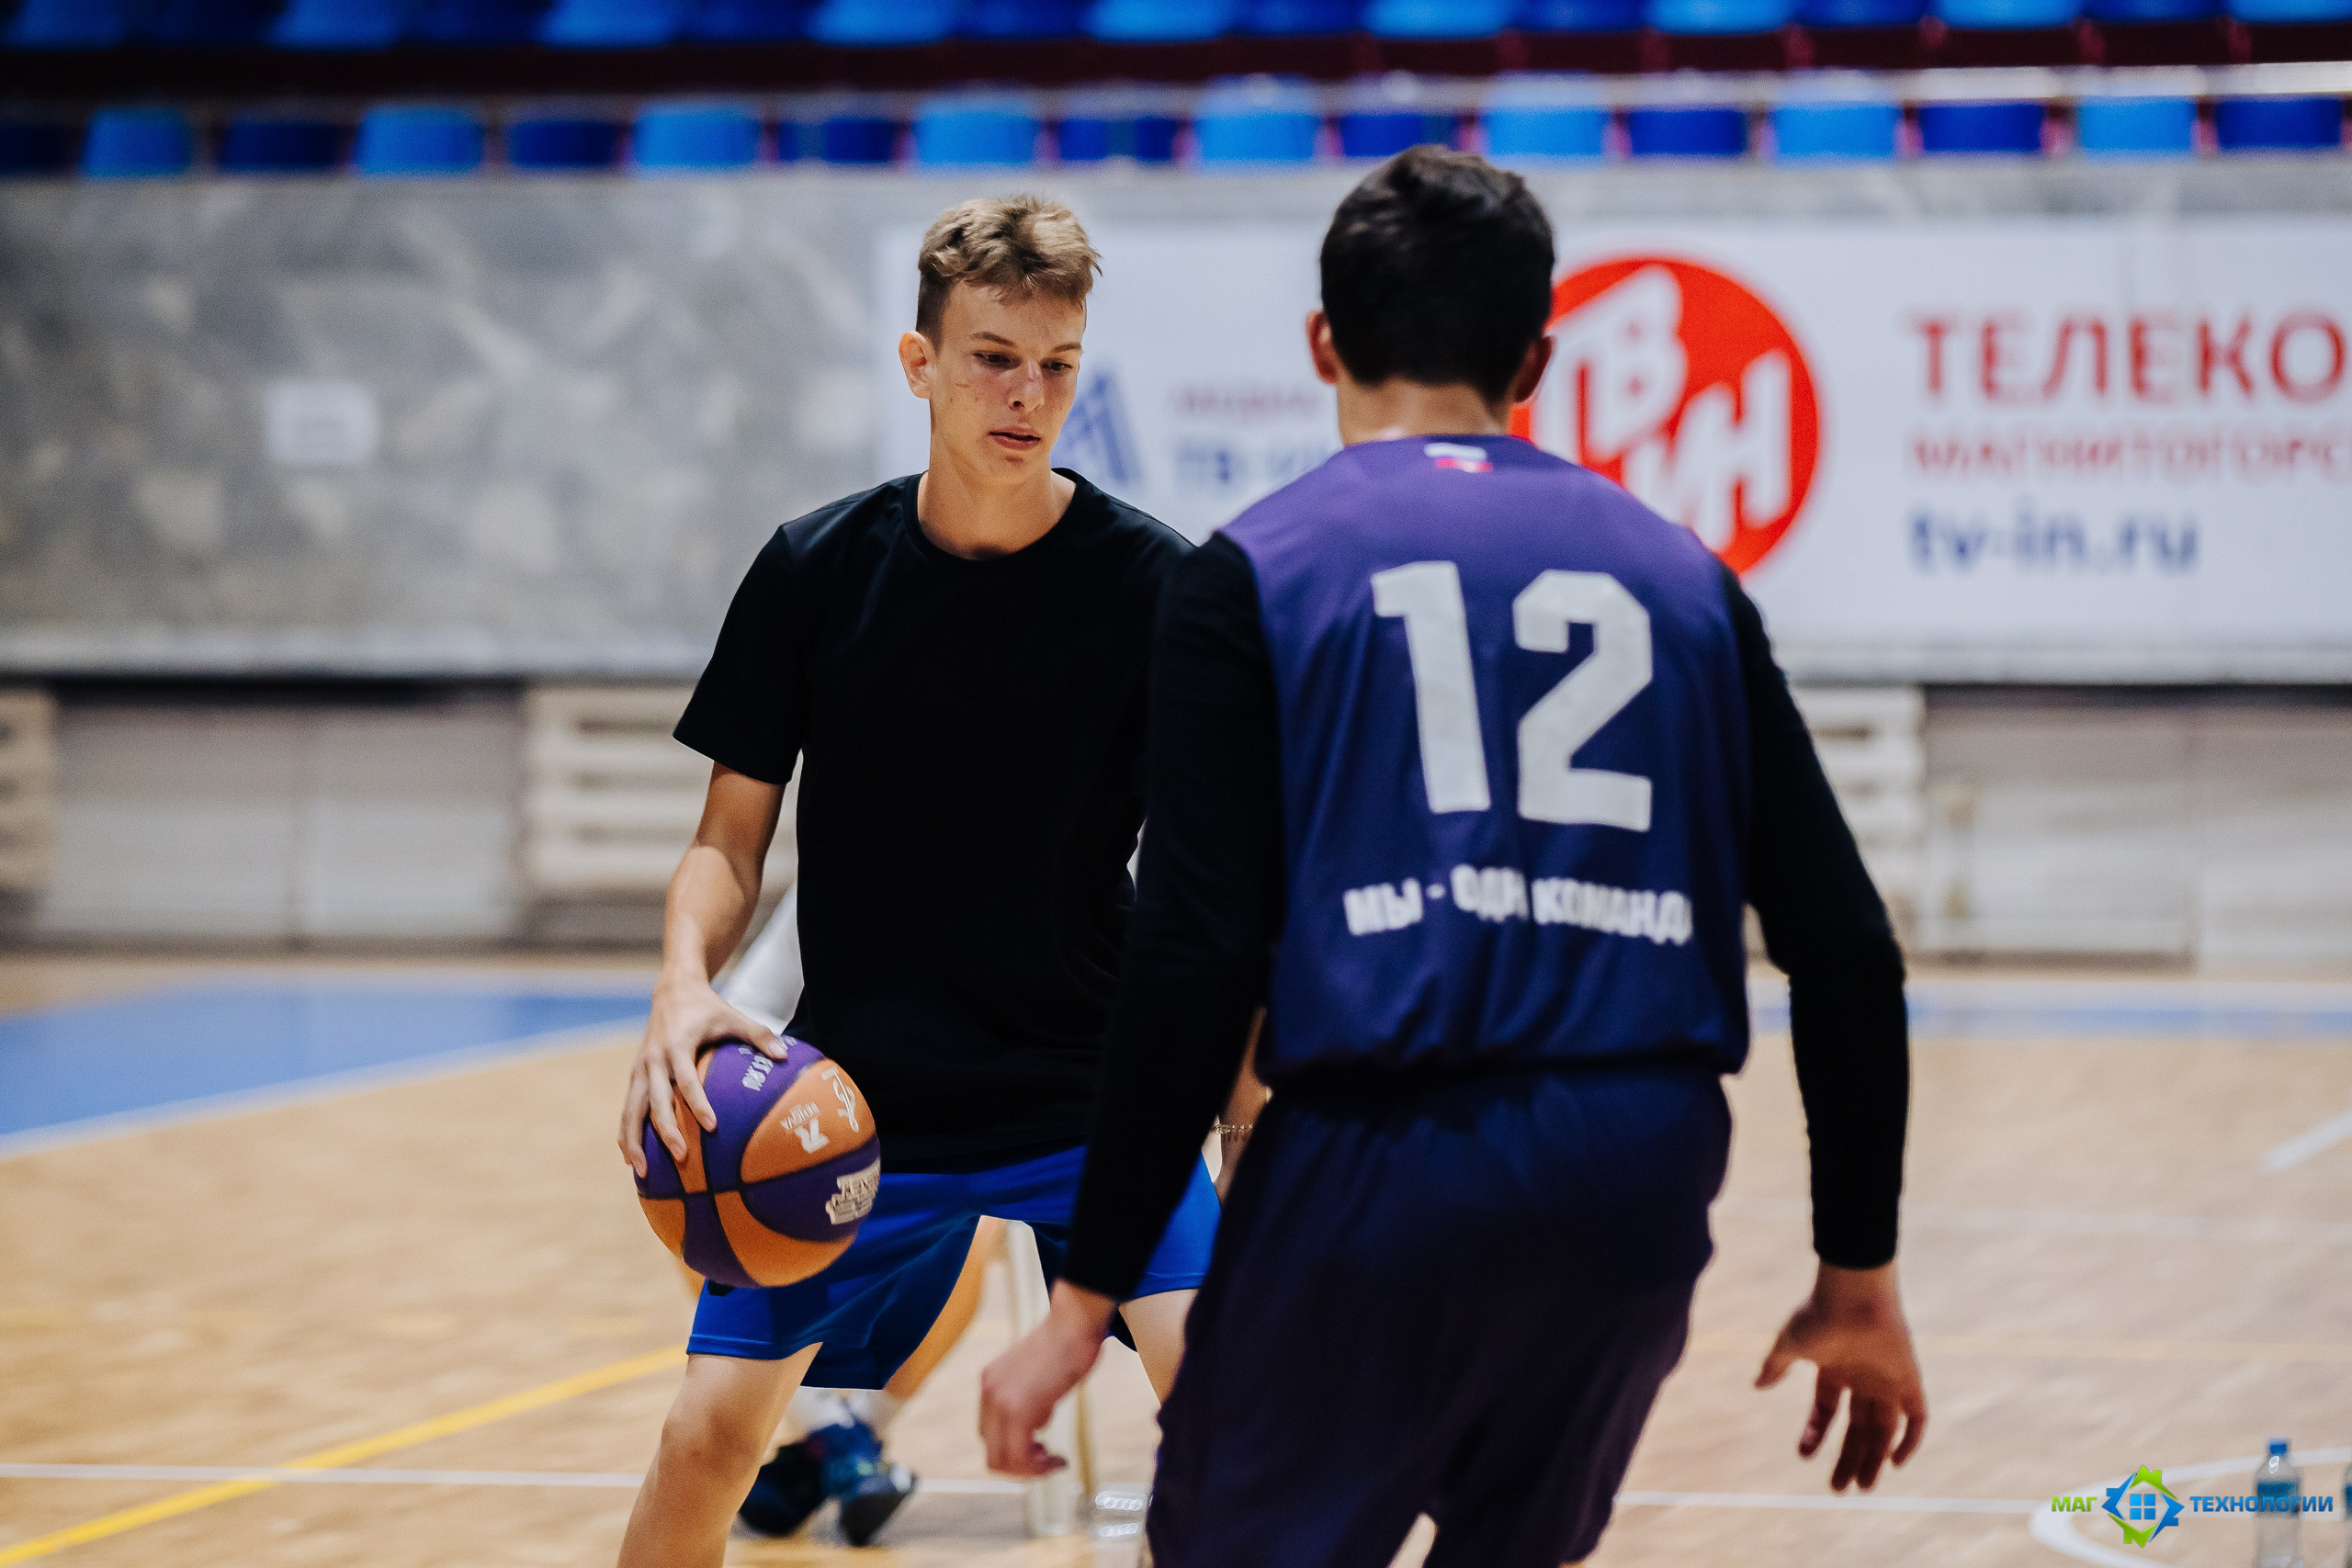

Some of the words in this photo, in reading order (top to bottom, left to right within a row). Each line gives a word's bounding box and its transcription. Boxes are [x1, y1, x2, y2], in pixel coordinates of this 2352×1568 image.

[1904, 308, 2348, 406] ТЕЛЕКО
[1909, 494, 2202, 581] tv-in.ru
[1371, 559, 1654, 832] 12
[1344, 878, 1423, 935] МЫ
